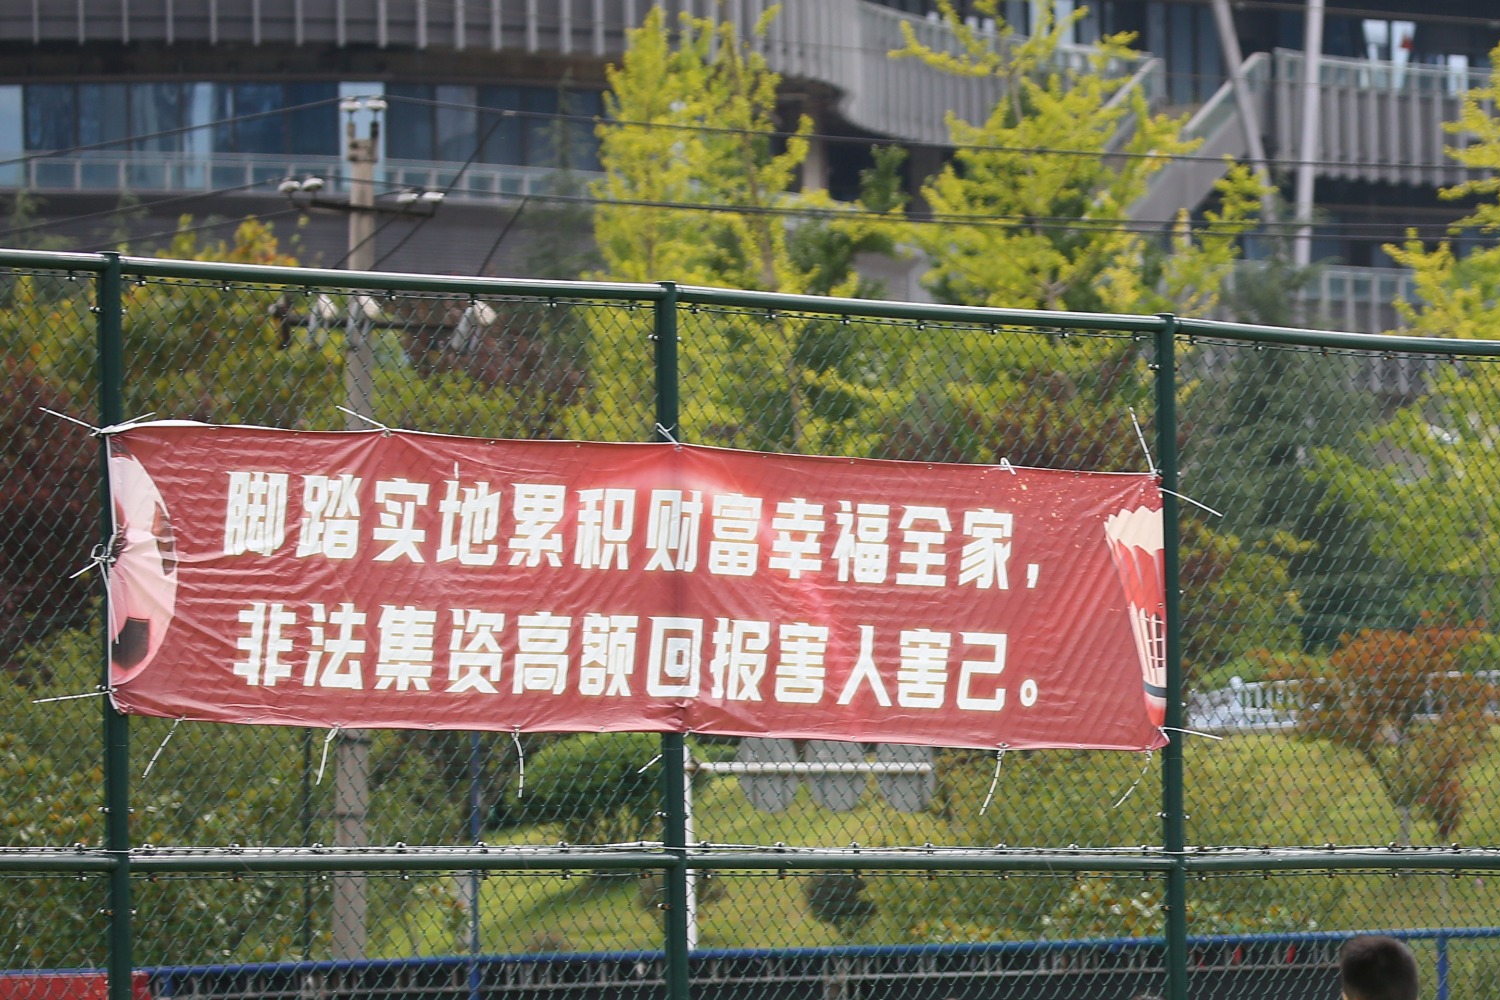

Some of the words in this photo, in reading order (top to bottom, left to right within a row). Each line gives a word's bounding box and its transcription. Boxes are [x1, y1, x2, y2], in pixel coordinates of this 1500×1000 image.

[223, 470, 1040, 590] 脚踏实地累积财富幸福全家，
[232, 601, 1039, 712] 非法集资高额回报害人害己。
